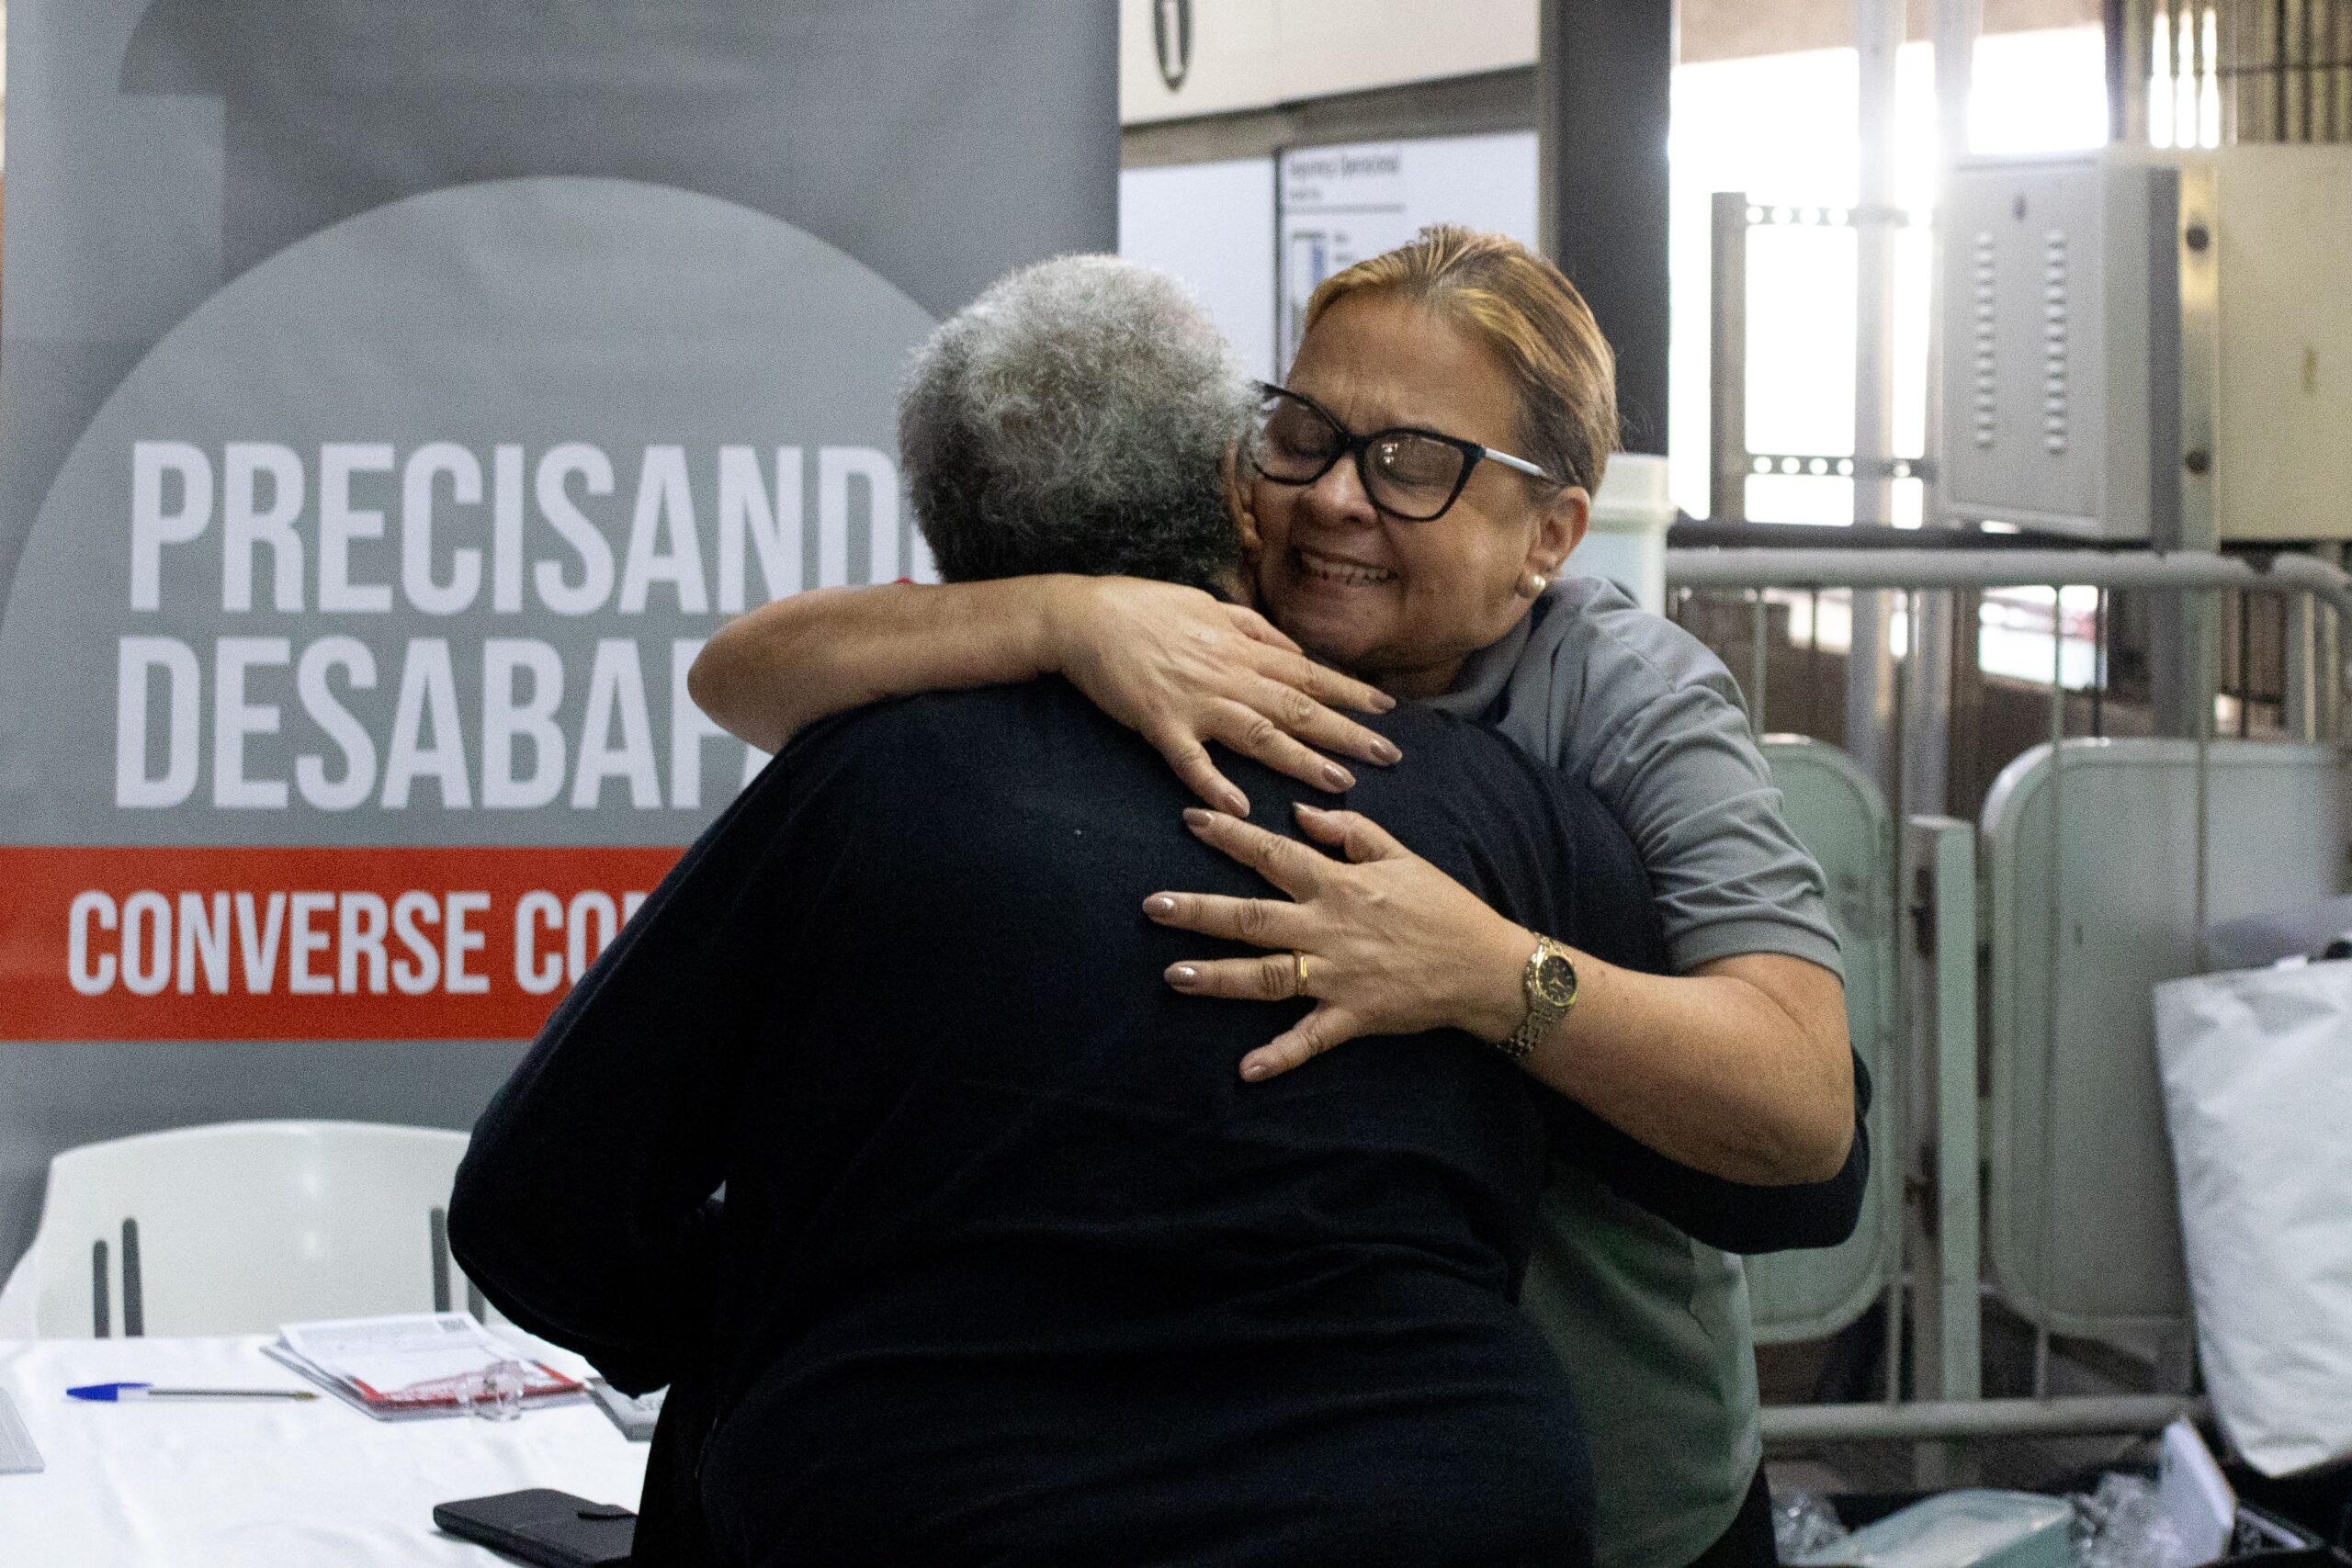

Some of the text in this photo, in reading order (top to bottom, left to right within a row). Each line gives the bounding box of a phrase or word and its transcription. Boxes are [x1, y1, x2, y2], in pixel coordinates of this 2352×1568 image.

[130, 441, 944, 615] PRECISAND
[116, 636, 777, 810] DESABAF
[69, 889, 649, 995] CONVERSE CO
